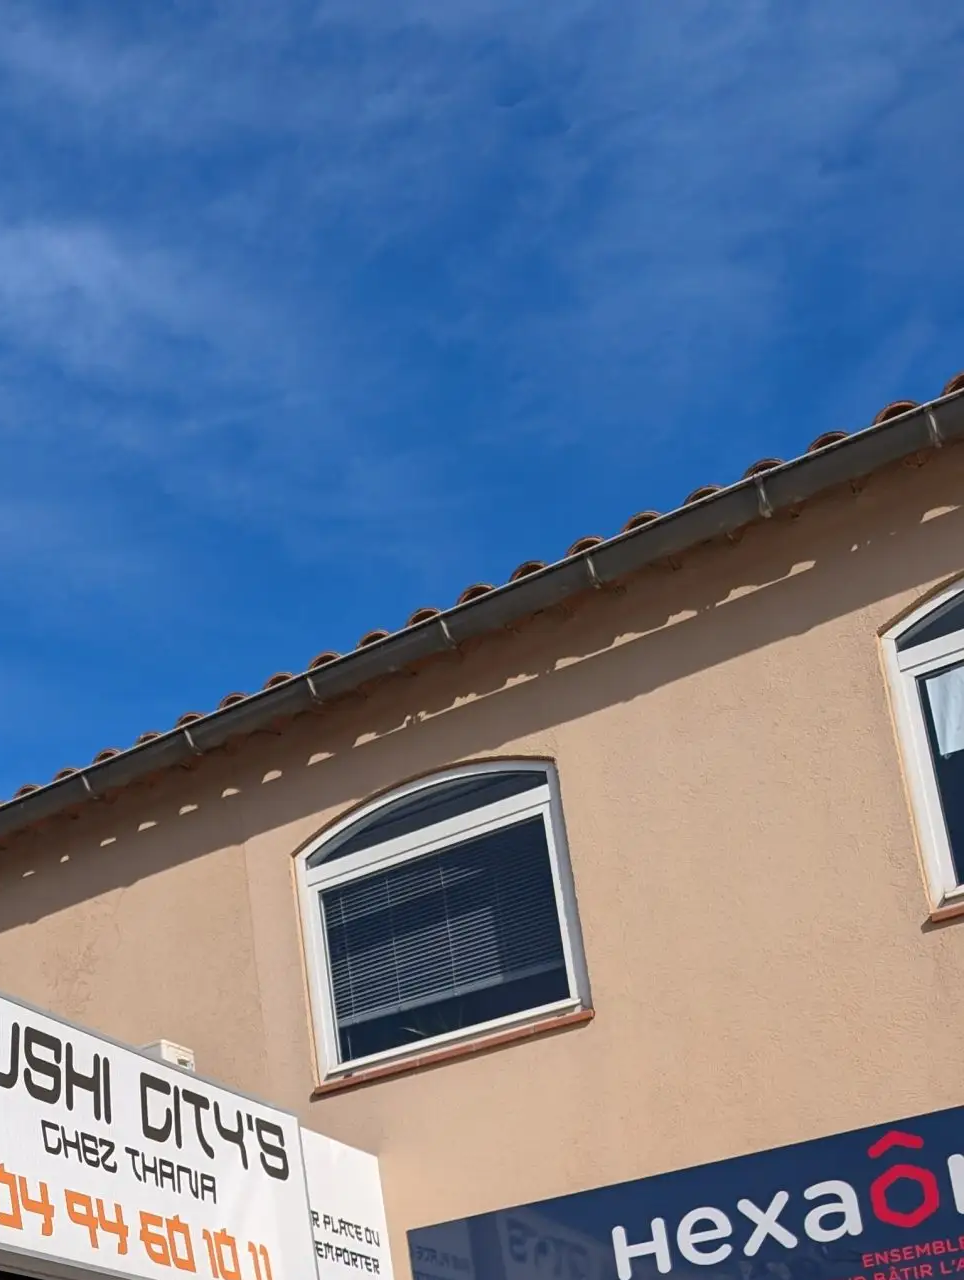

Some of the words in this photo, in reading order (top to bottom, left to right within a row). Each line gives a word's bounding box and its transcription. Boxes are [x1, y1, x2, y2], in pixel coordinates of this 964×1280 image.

[40, 1119, 118, 1174] CHEZ
[124, 1147, 217, 1205] THANA
[139, 1072, 290, 1182] CITY'S
[64, 1188, 129, 1256] 94
[138, 1211, 197, 1273] 60
[314, 1240, 381, 1275] EMPORTER
[322, 1214, 363, 1241] PLACE
[364, 1226, 381, 1248] OU
